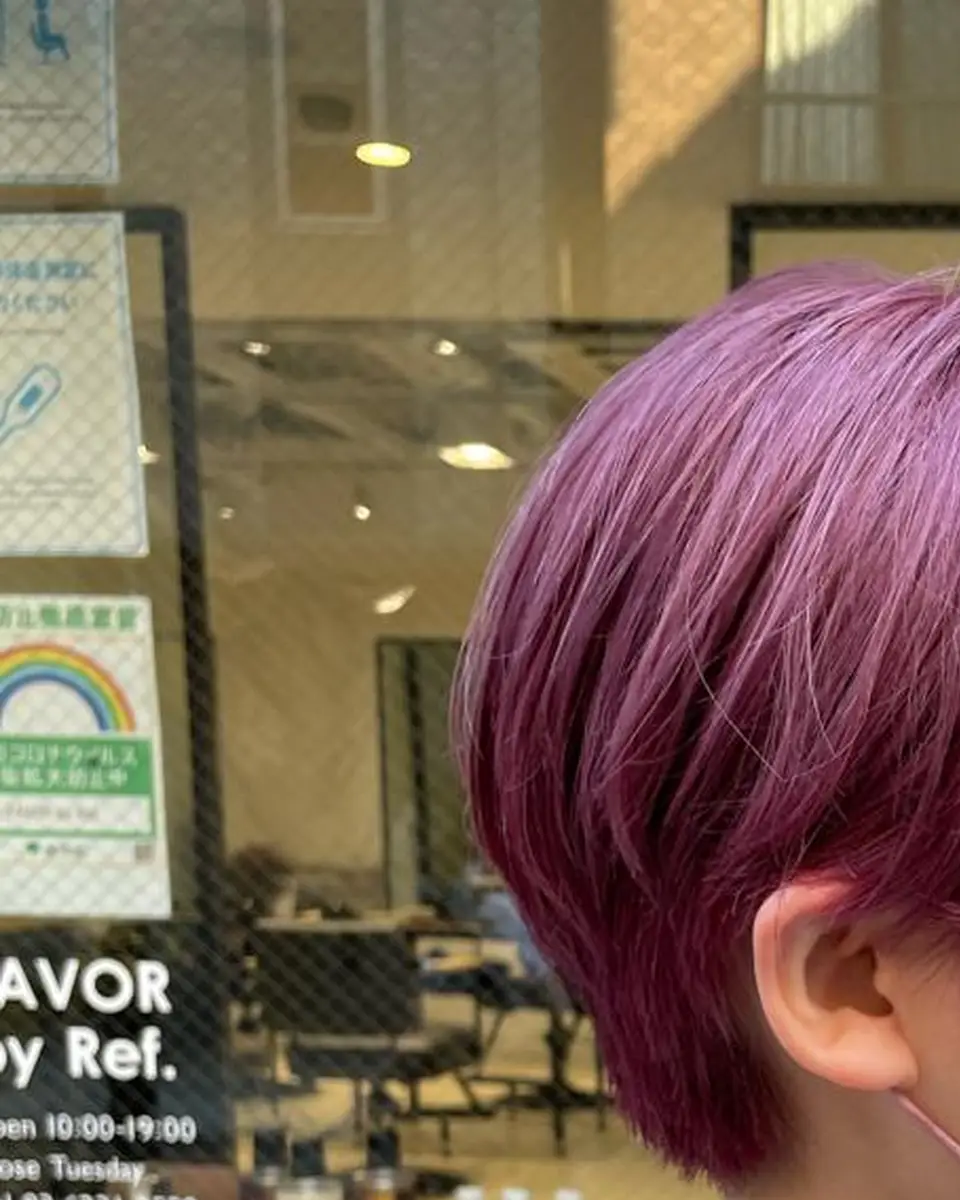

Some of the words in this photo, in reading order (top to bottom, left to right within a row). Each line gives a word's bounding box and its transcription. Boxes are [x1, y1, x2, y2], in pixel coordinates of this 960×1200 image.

[0, 956, 172, 1014] AVOR
[65, 1025, 177, 1081] Ref.
[46, 1111, 197, 1145] 10:00-19:00
[47, 1153, 147, 1187] Tuesday
